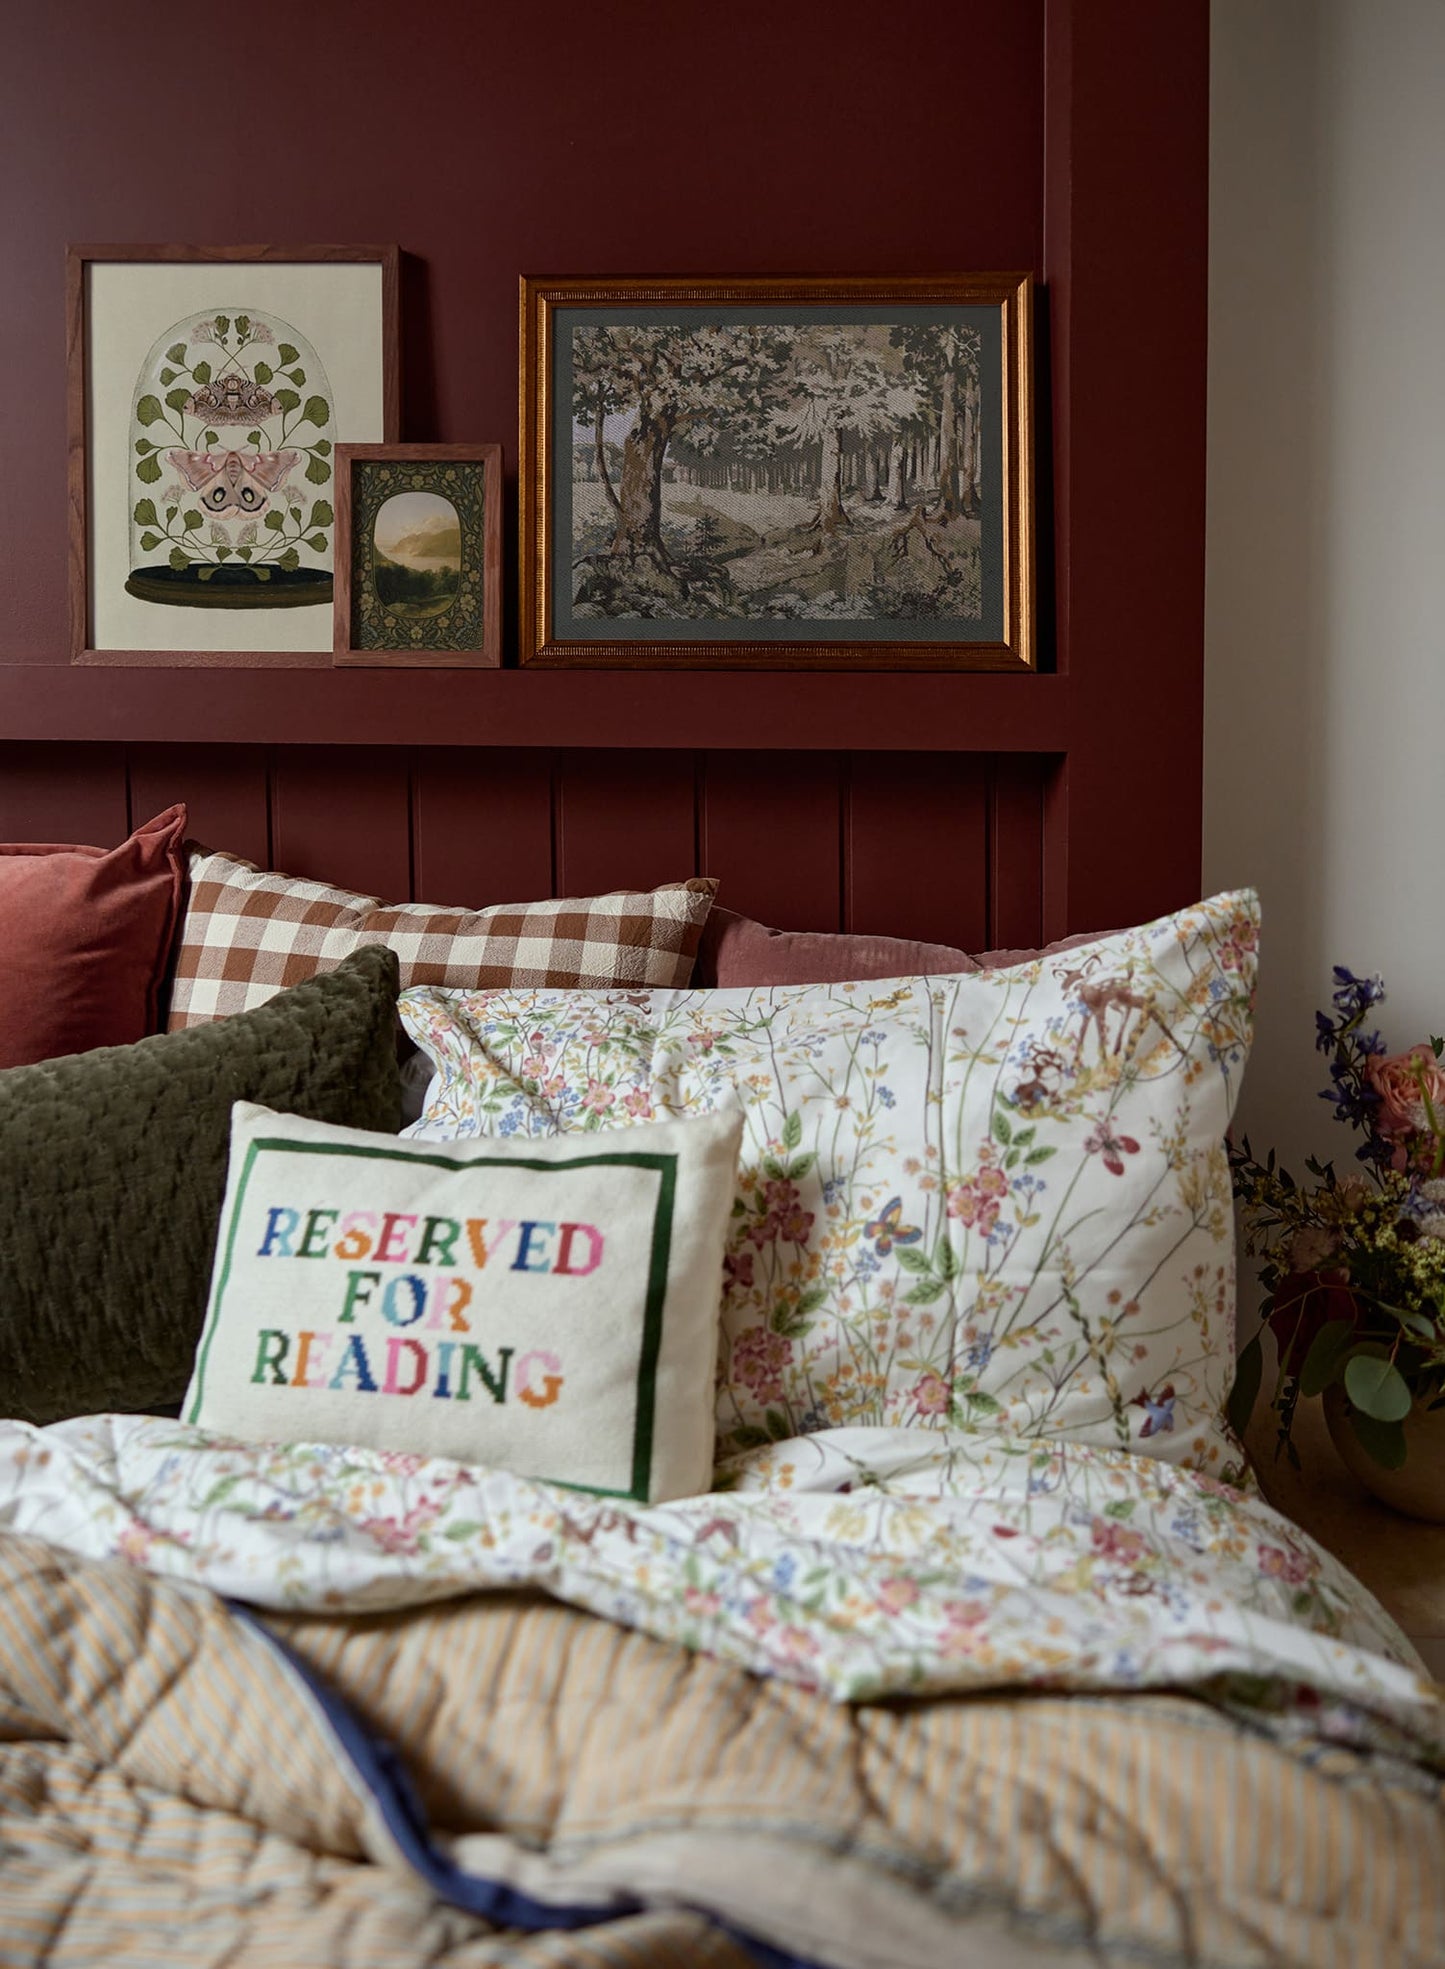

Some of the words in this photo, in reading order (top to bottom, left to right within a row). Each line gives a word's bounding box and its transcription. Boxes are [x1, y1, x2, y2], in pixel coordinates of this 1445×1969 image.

[257, 1207, 604, 1277] RESERVED
[338, 1270, 473, 1332] FOR
[250, 1329, 564, 1409] READING
